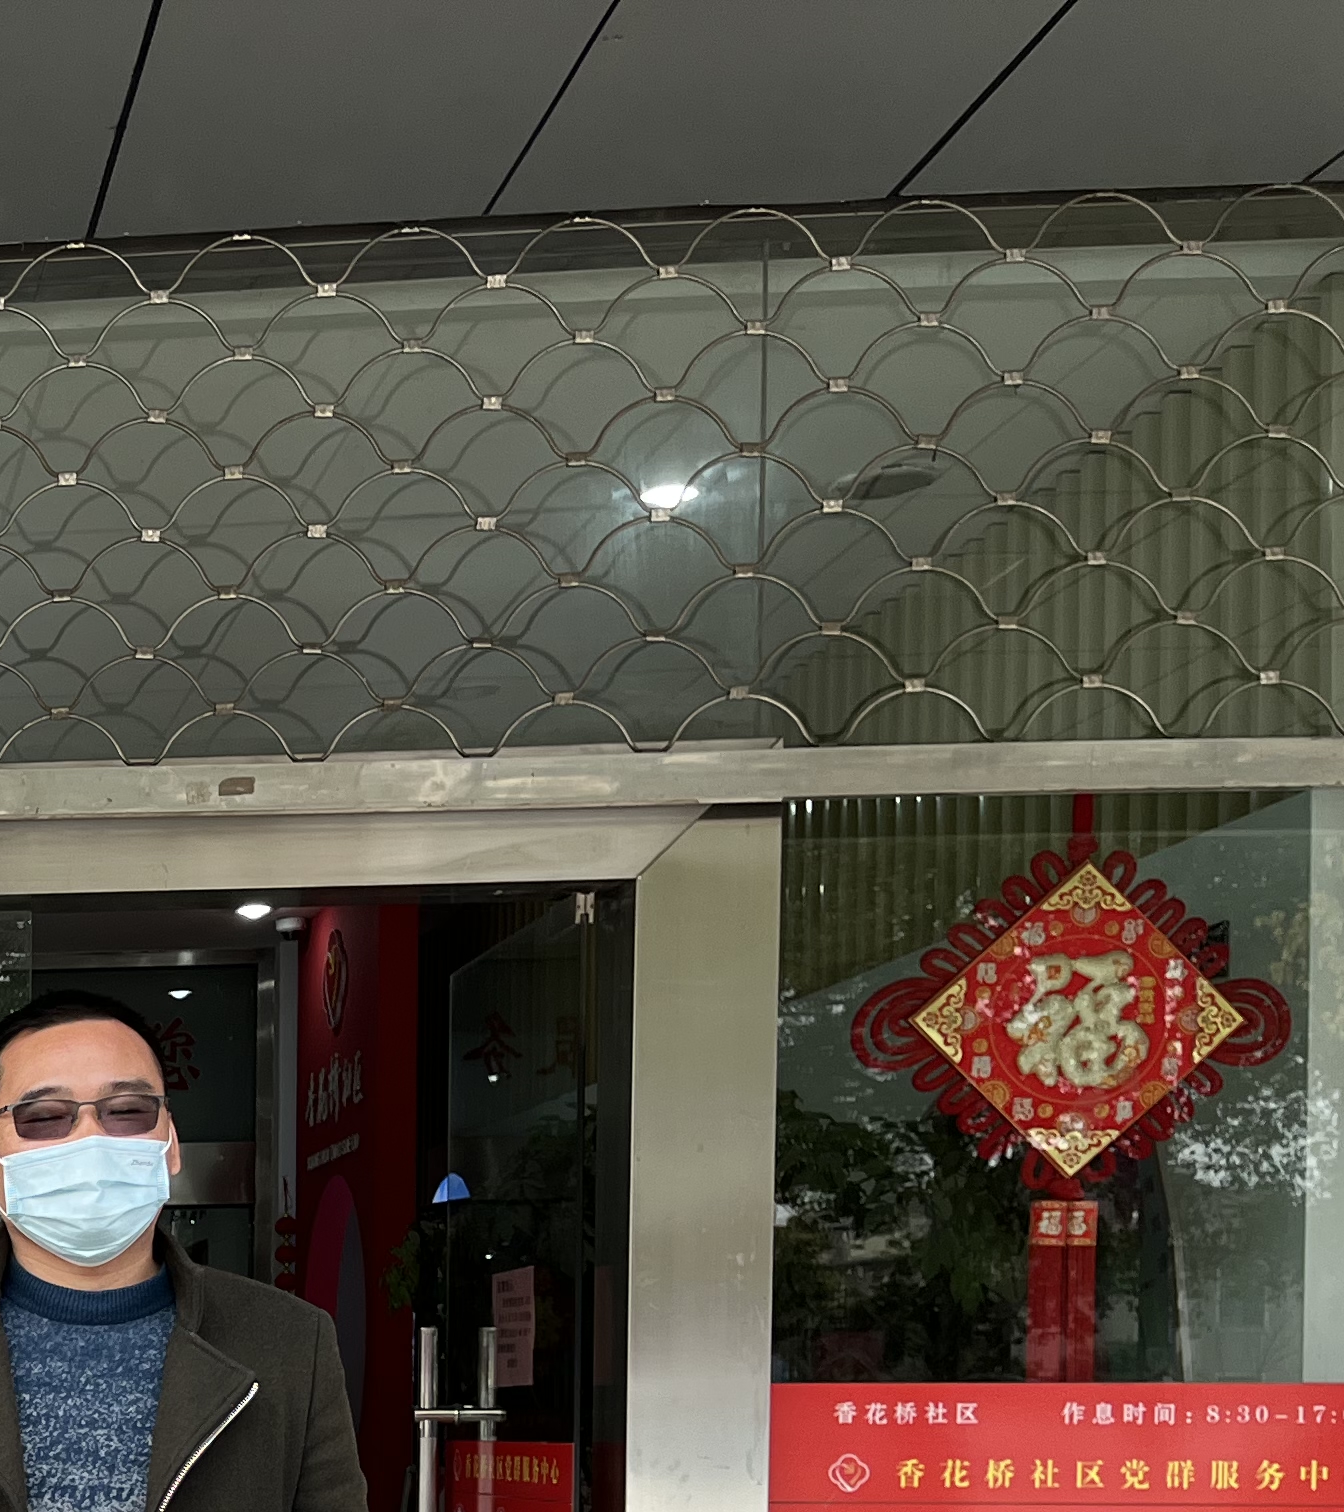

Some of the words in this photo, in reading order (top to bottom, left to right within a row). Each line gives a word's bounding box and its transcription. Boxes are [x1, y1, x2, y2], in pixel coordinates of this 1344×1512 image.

[834, 1402, 980, 1425] 香花桥社区
[897, 1458, 1330, 1491] 香花桥社区党群服务中
